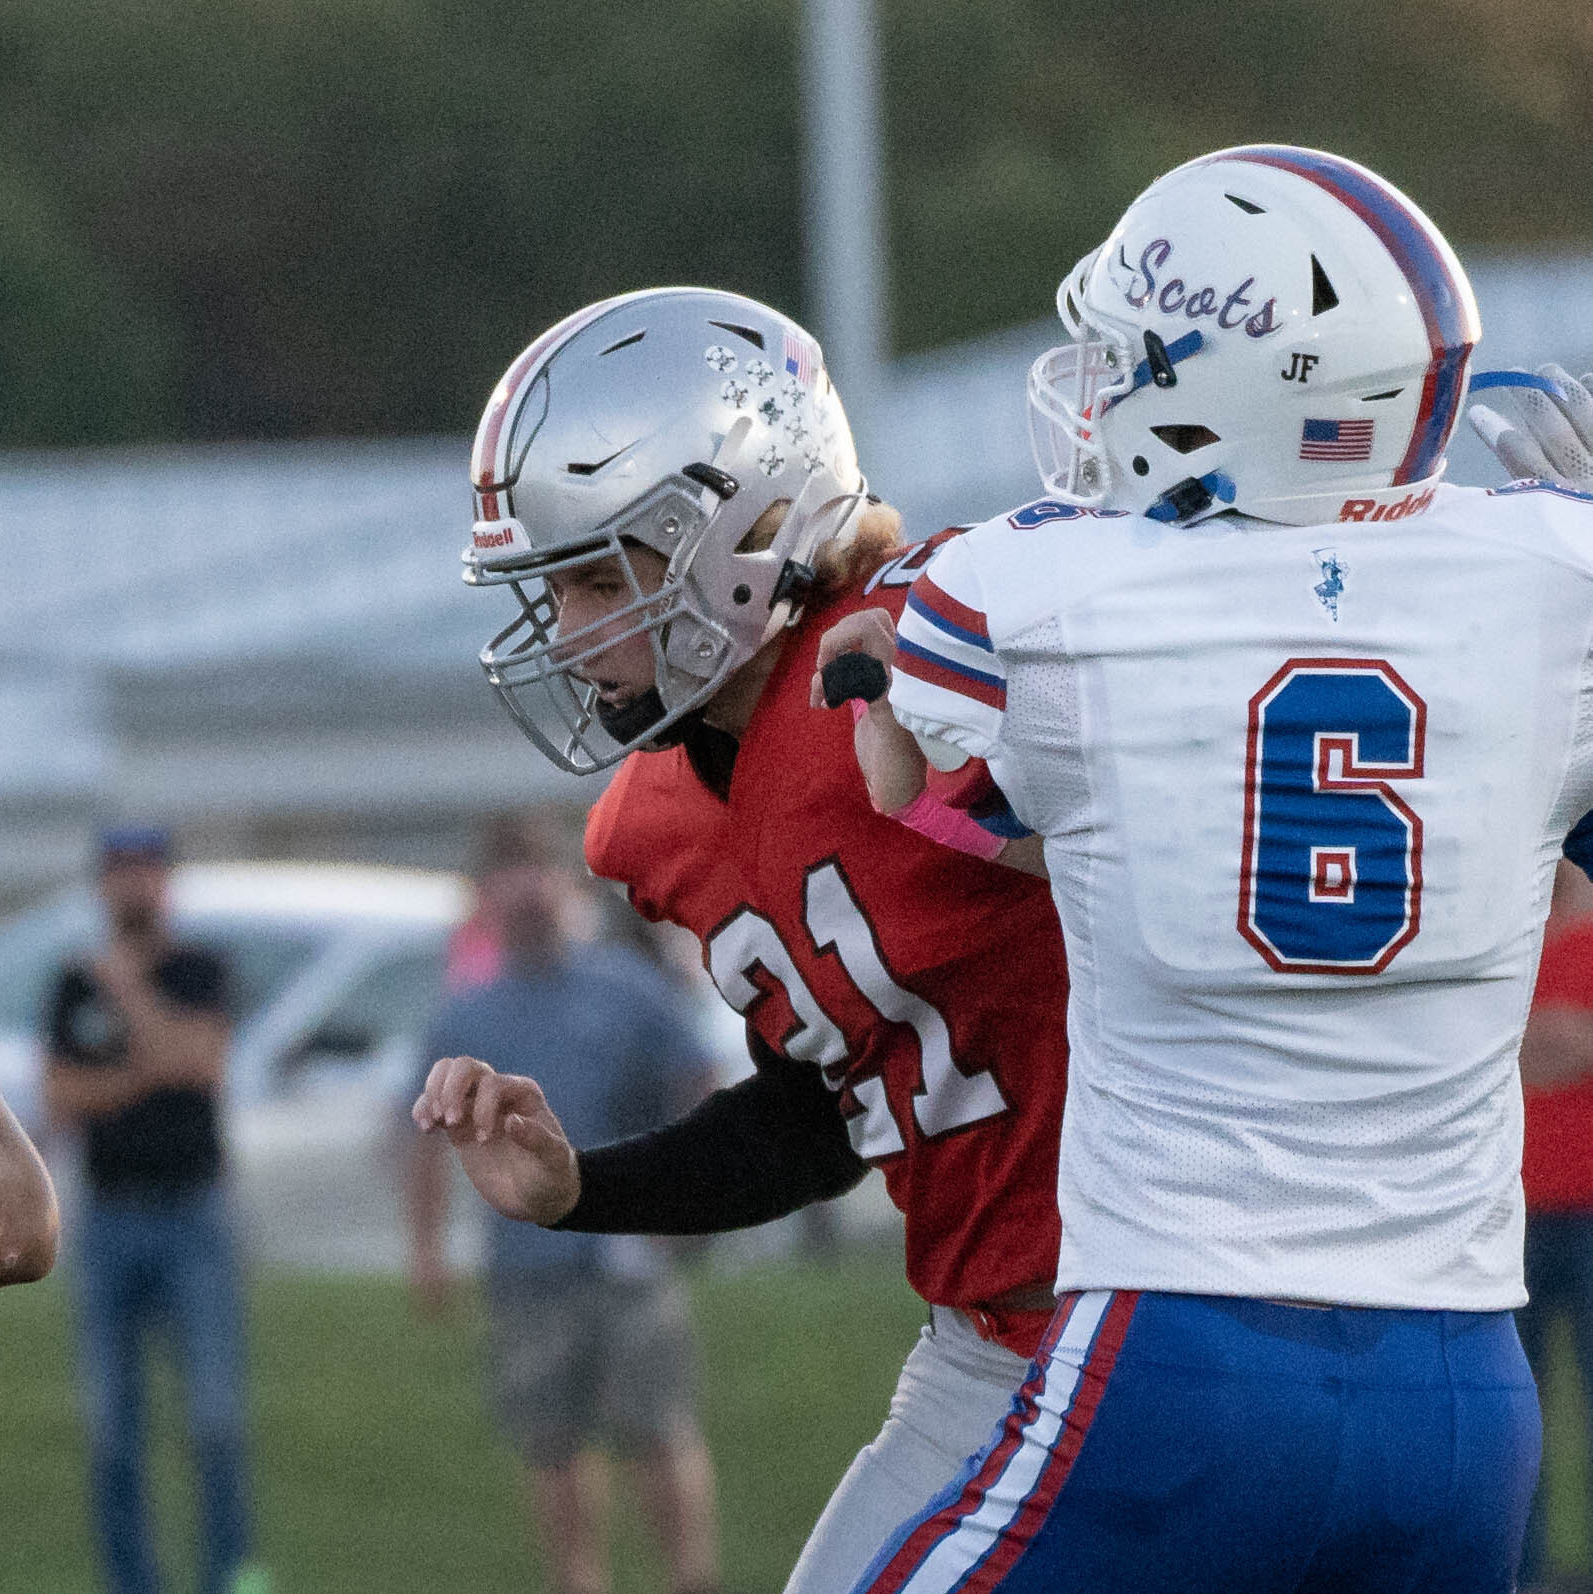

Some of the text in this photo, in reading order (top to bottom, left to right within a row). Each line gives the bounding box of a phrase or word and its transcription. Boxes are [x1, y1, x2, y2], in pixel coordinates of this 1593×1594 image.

[1124, 238, 1285, 339] Scots
[1281, 352, 1320, 385] JF
[1236, 657, 1428, 976] 6
[705, 856, 1010, 1163] 21
